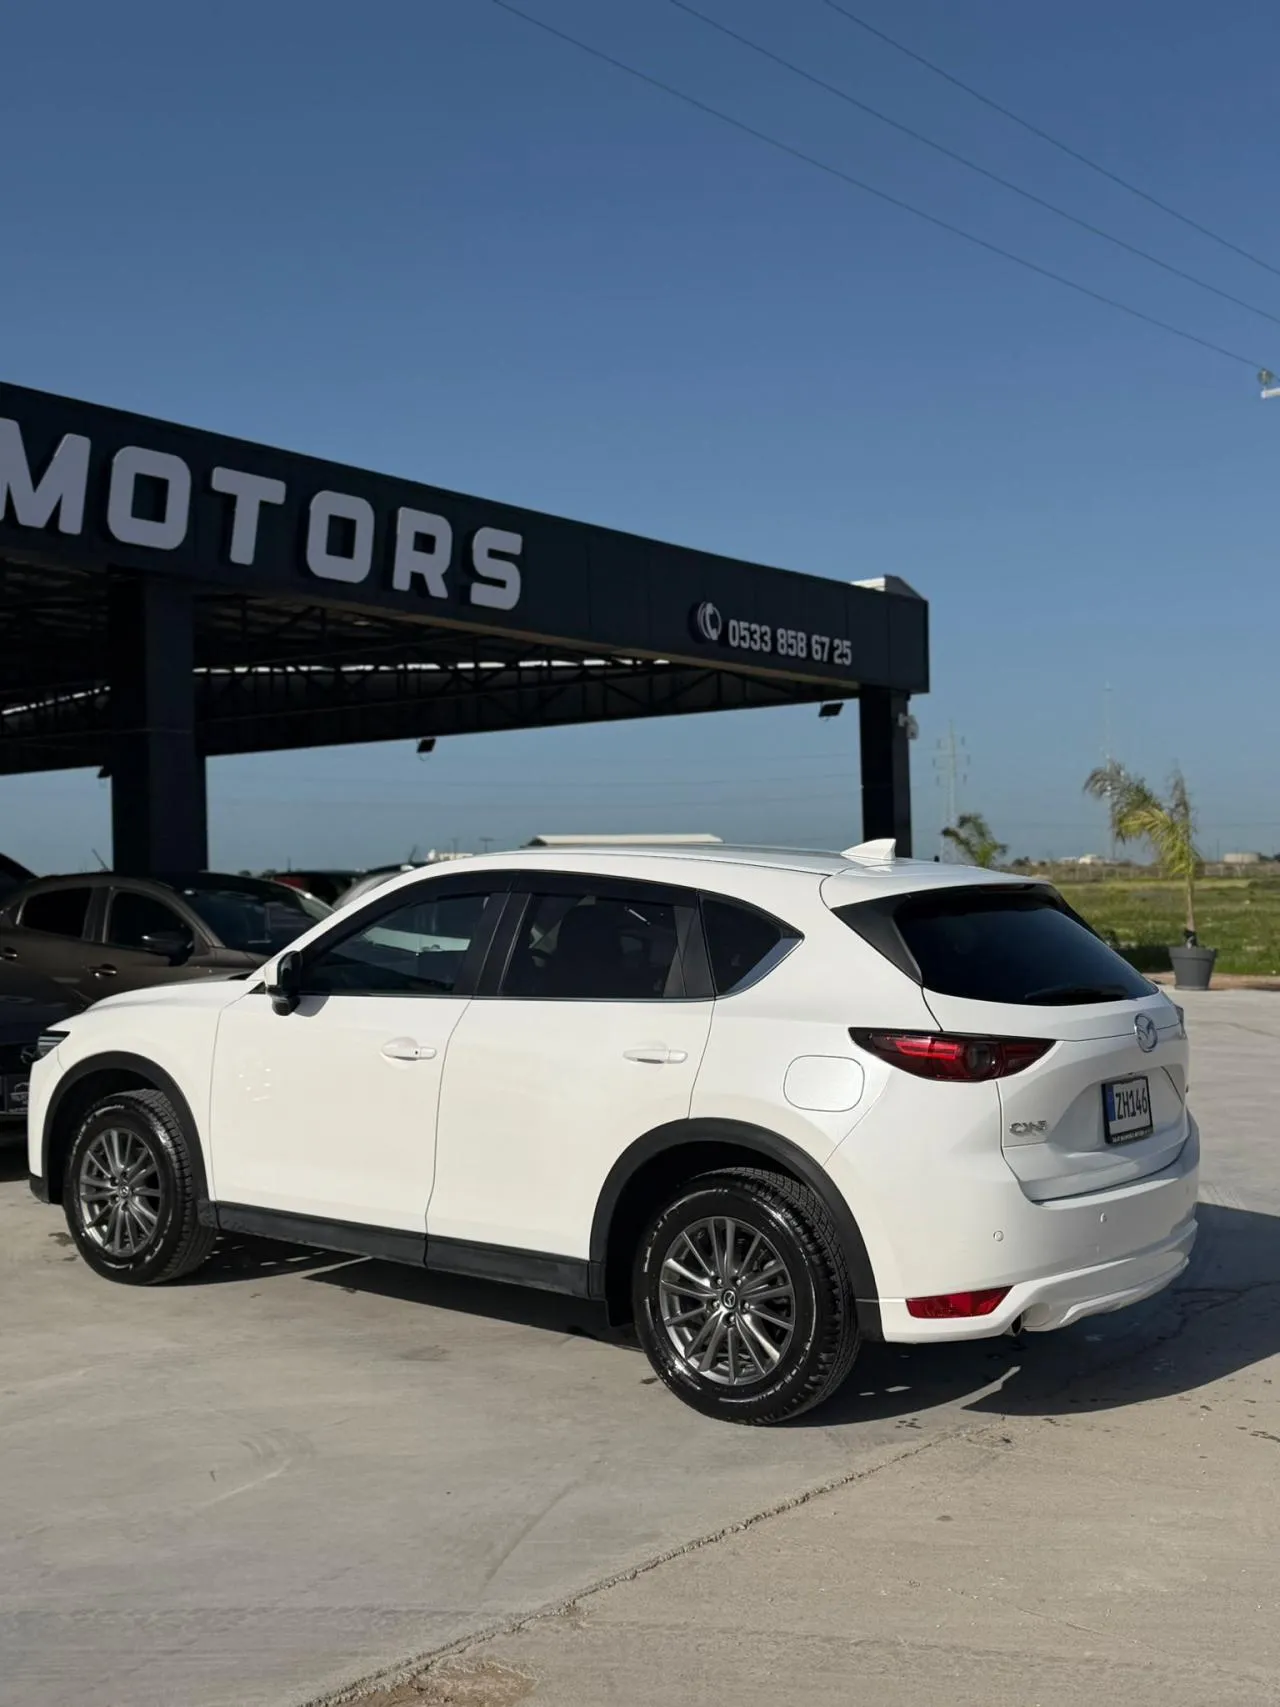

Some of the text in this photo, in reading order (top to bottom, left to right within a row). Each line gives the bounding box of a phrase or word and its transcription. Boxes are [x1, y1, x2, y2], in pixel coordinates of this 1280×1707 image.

[0, 417, 523, 610] MOTORS
[728, 619, 852, 666] 0533 858 67 25
